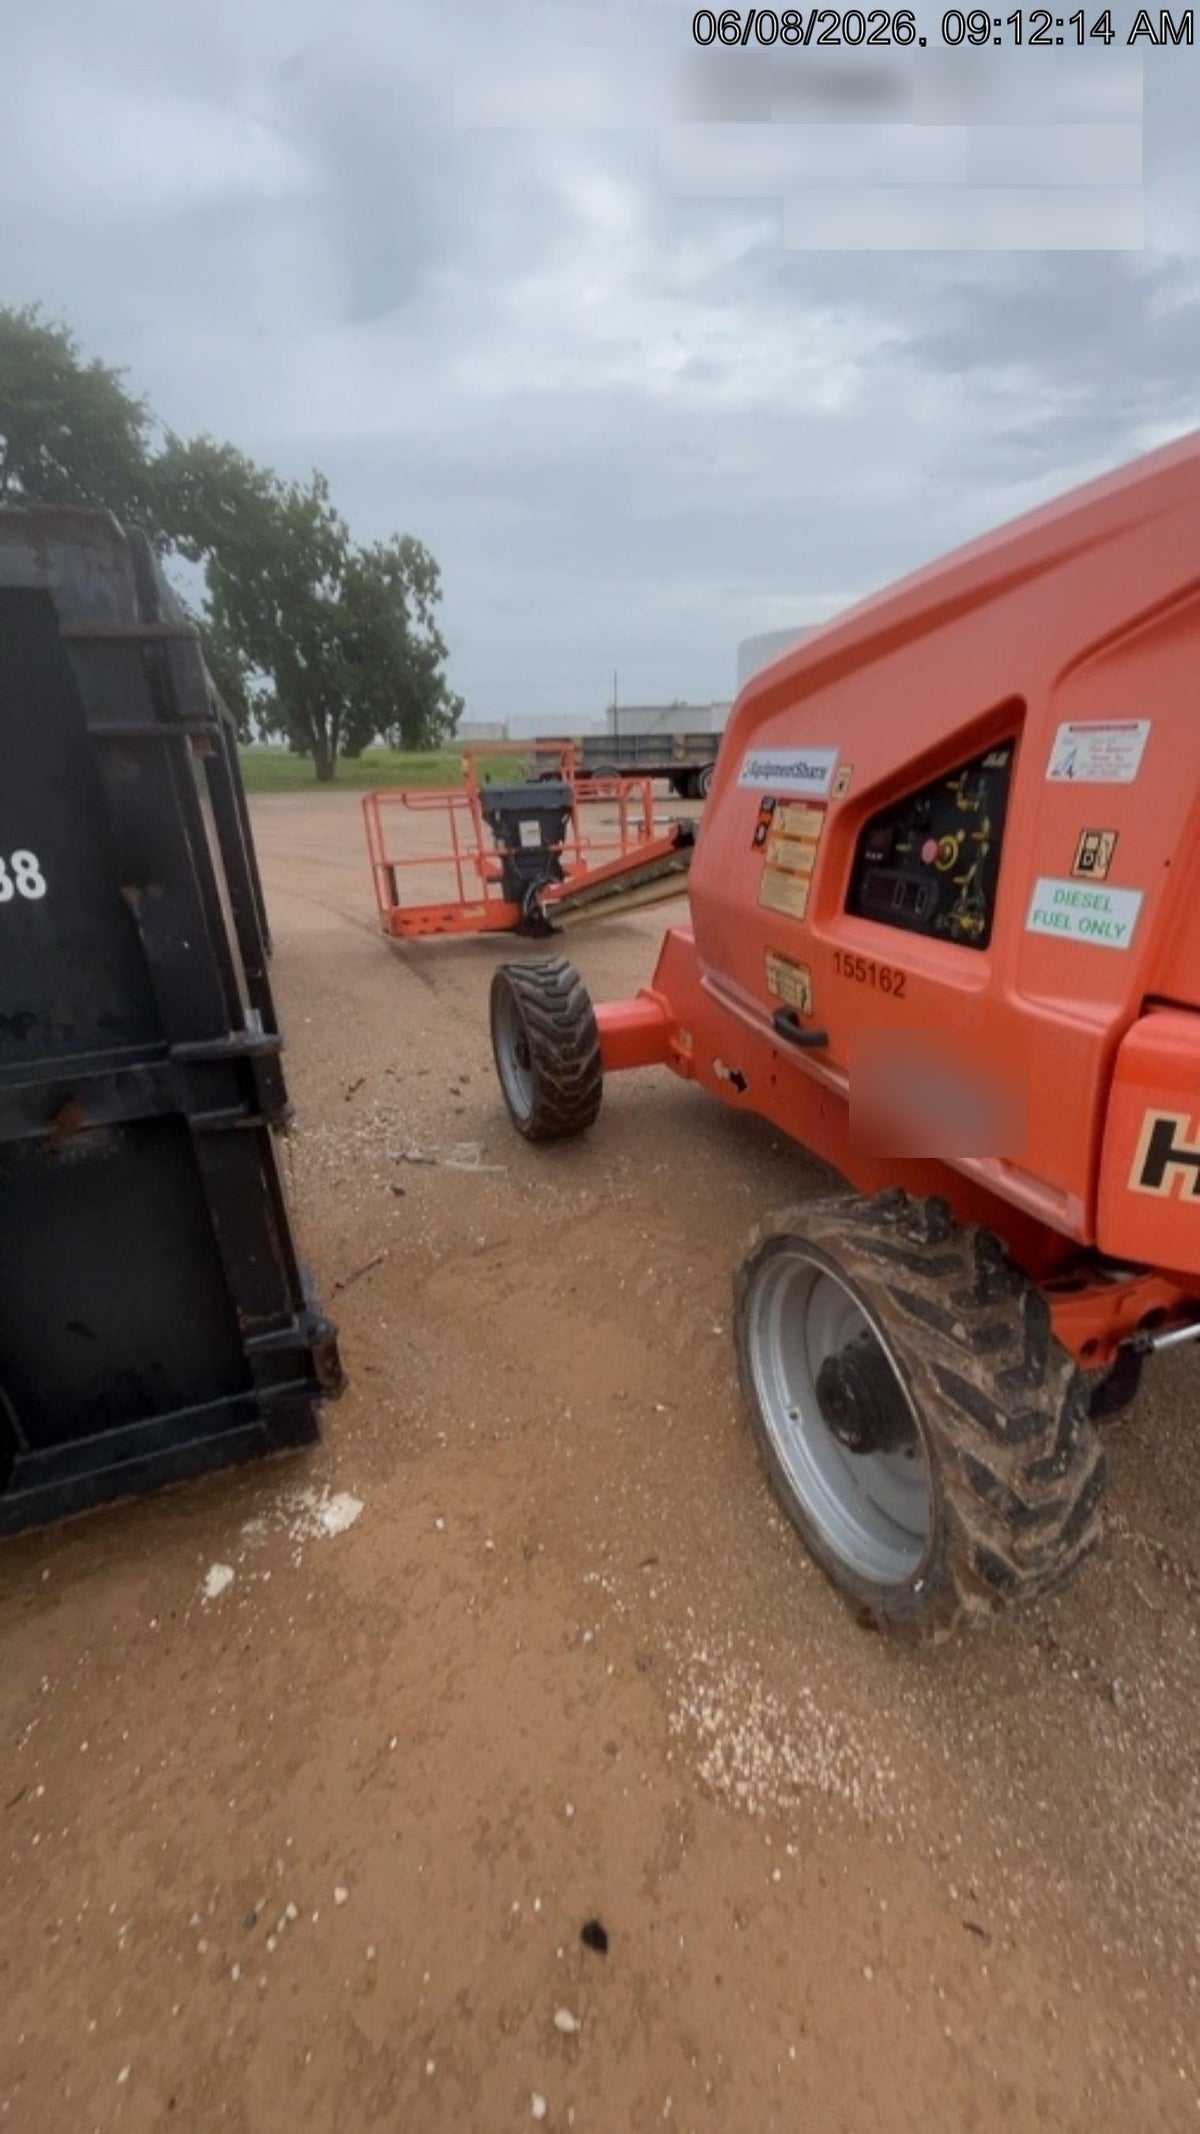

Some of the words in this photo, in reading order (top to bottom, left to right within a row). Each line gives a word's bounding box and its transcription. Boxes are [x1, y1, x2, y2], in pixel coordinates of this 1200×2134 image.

[1053, 888, 1112, 913] DIESEL
[1033, 908, 1072, 931] FUEL
[1078, 917, 1127, 939] ONLY
[833, 951, 907, 999] 155162
